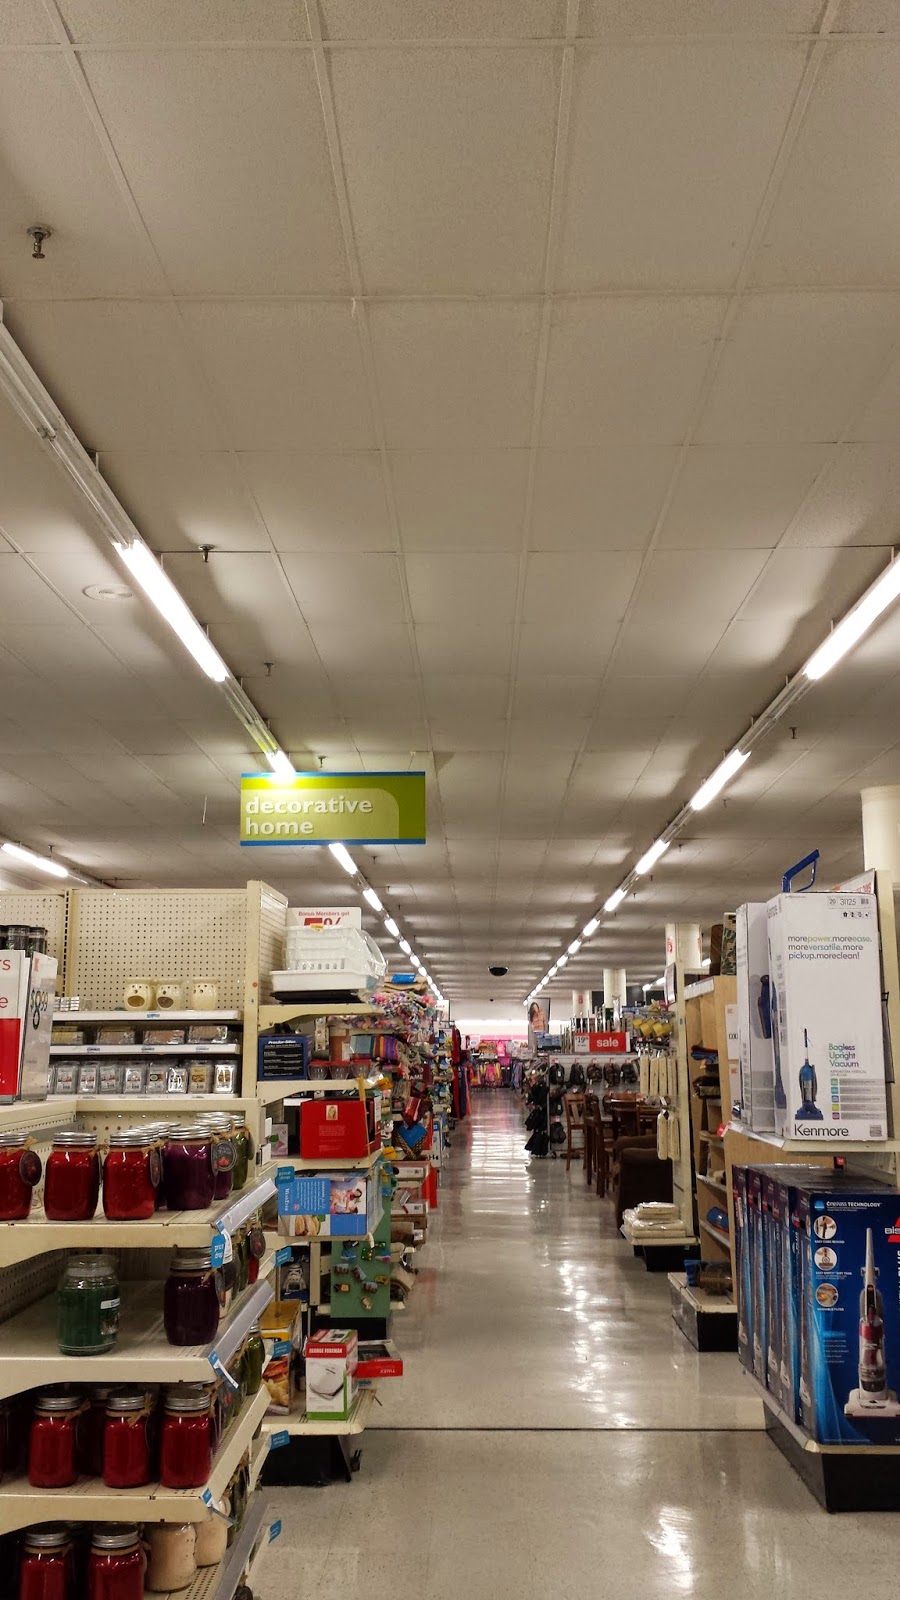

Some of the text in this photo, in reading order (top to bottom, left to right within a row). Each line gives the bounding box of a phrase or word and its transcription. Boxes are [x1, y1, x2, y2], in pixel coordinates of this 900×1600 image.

[245, 796, 373, 814] decorative
[245, 817, 314, 835] home
[596, 1037, 619, 1048] sale
[828, 1043, 856, 1052] Bagless
[829, 1052, 856, 1060] Upright
[829, 1060, 860, 1068] Vacuum
[794, 1123, 850, 1138] Kenmore
